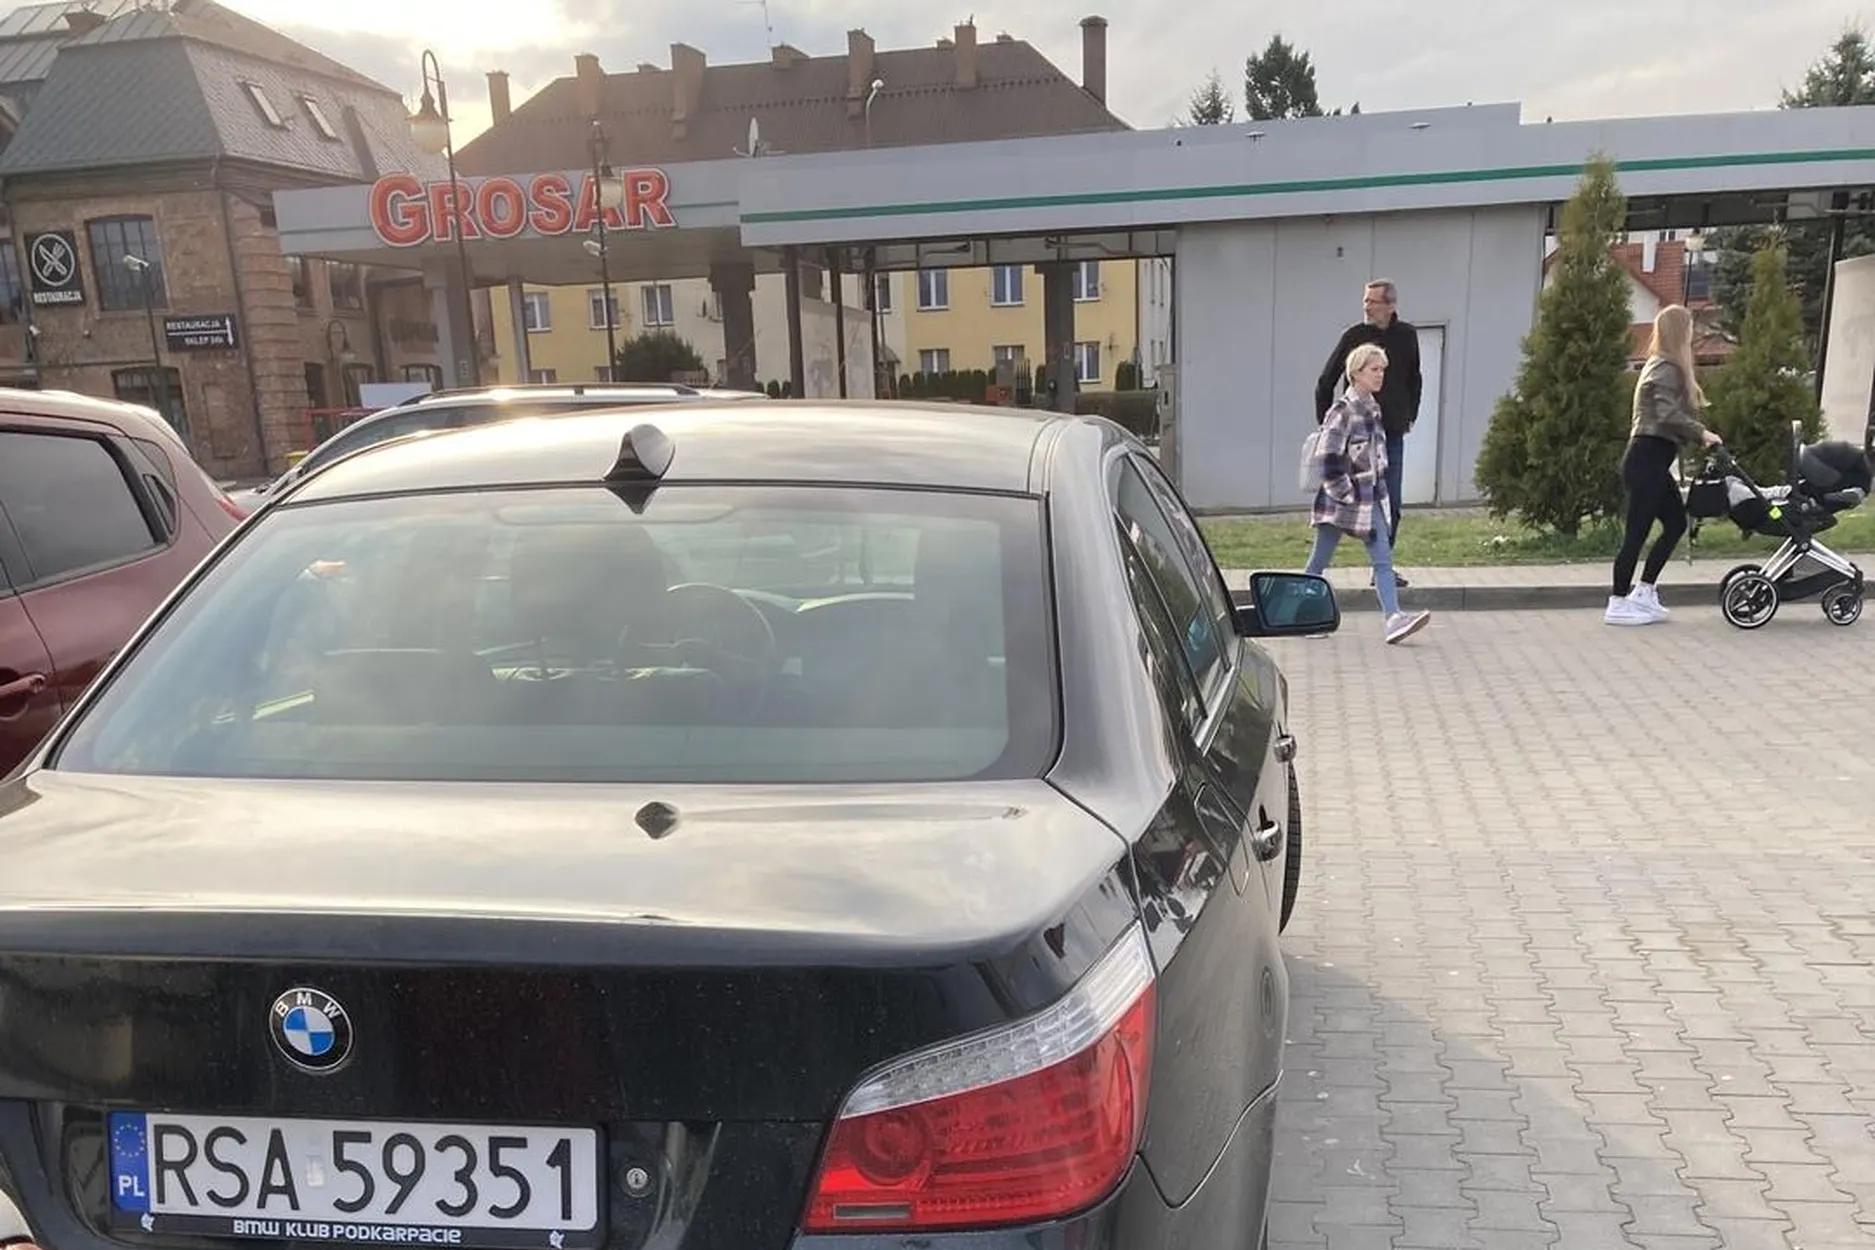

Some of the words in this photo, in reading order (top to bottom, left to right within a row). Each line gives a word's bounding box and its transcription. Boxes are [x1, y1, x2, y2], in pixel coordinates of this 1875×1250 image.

[370, 168, 676, 247] GROSAR
[275, 992, 341, 1018] BMW
[153, 1124, 300, 1211] RSA
[333, 1130, 572, 1221] 59351
[118, 1175, 145, 1197] PL
[233, 1219, 280, 1236] BMW
[286, 1224, 330, 1238] KLUB
